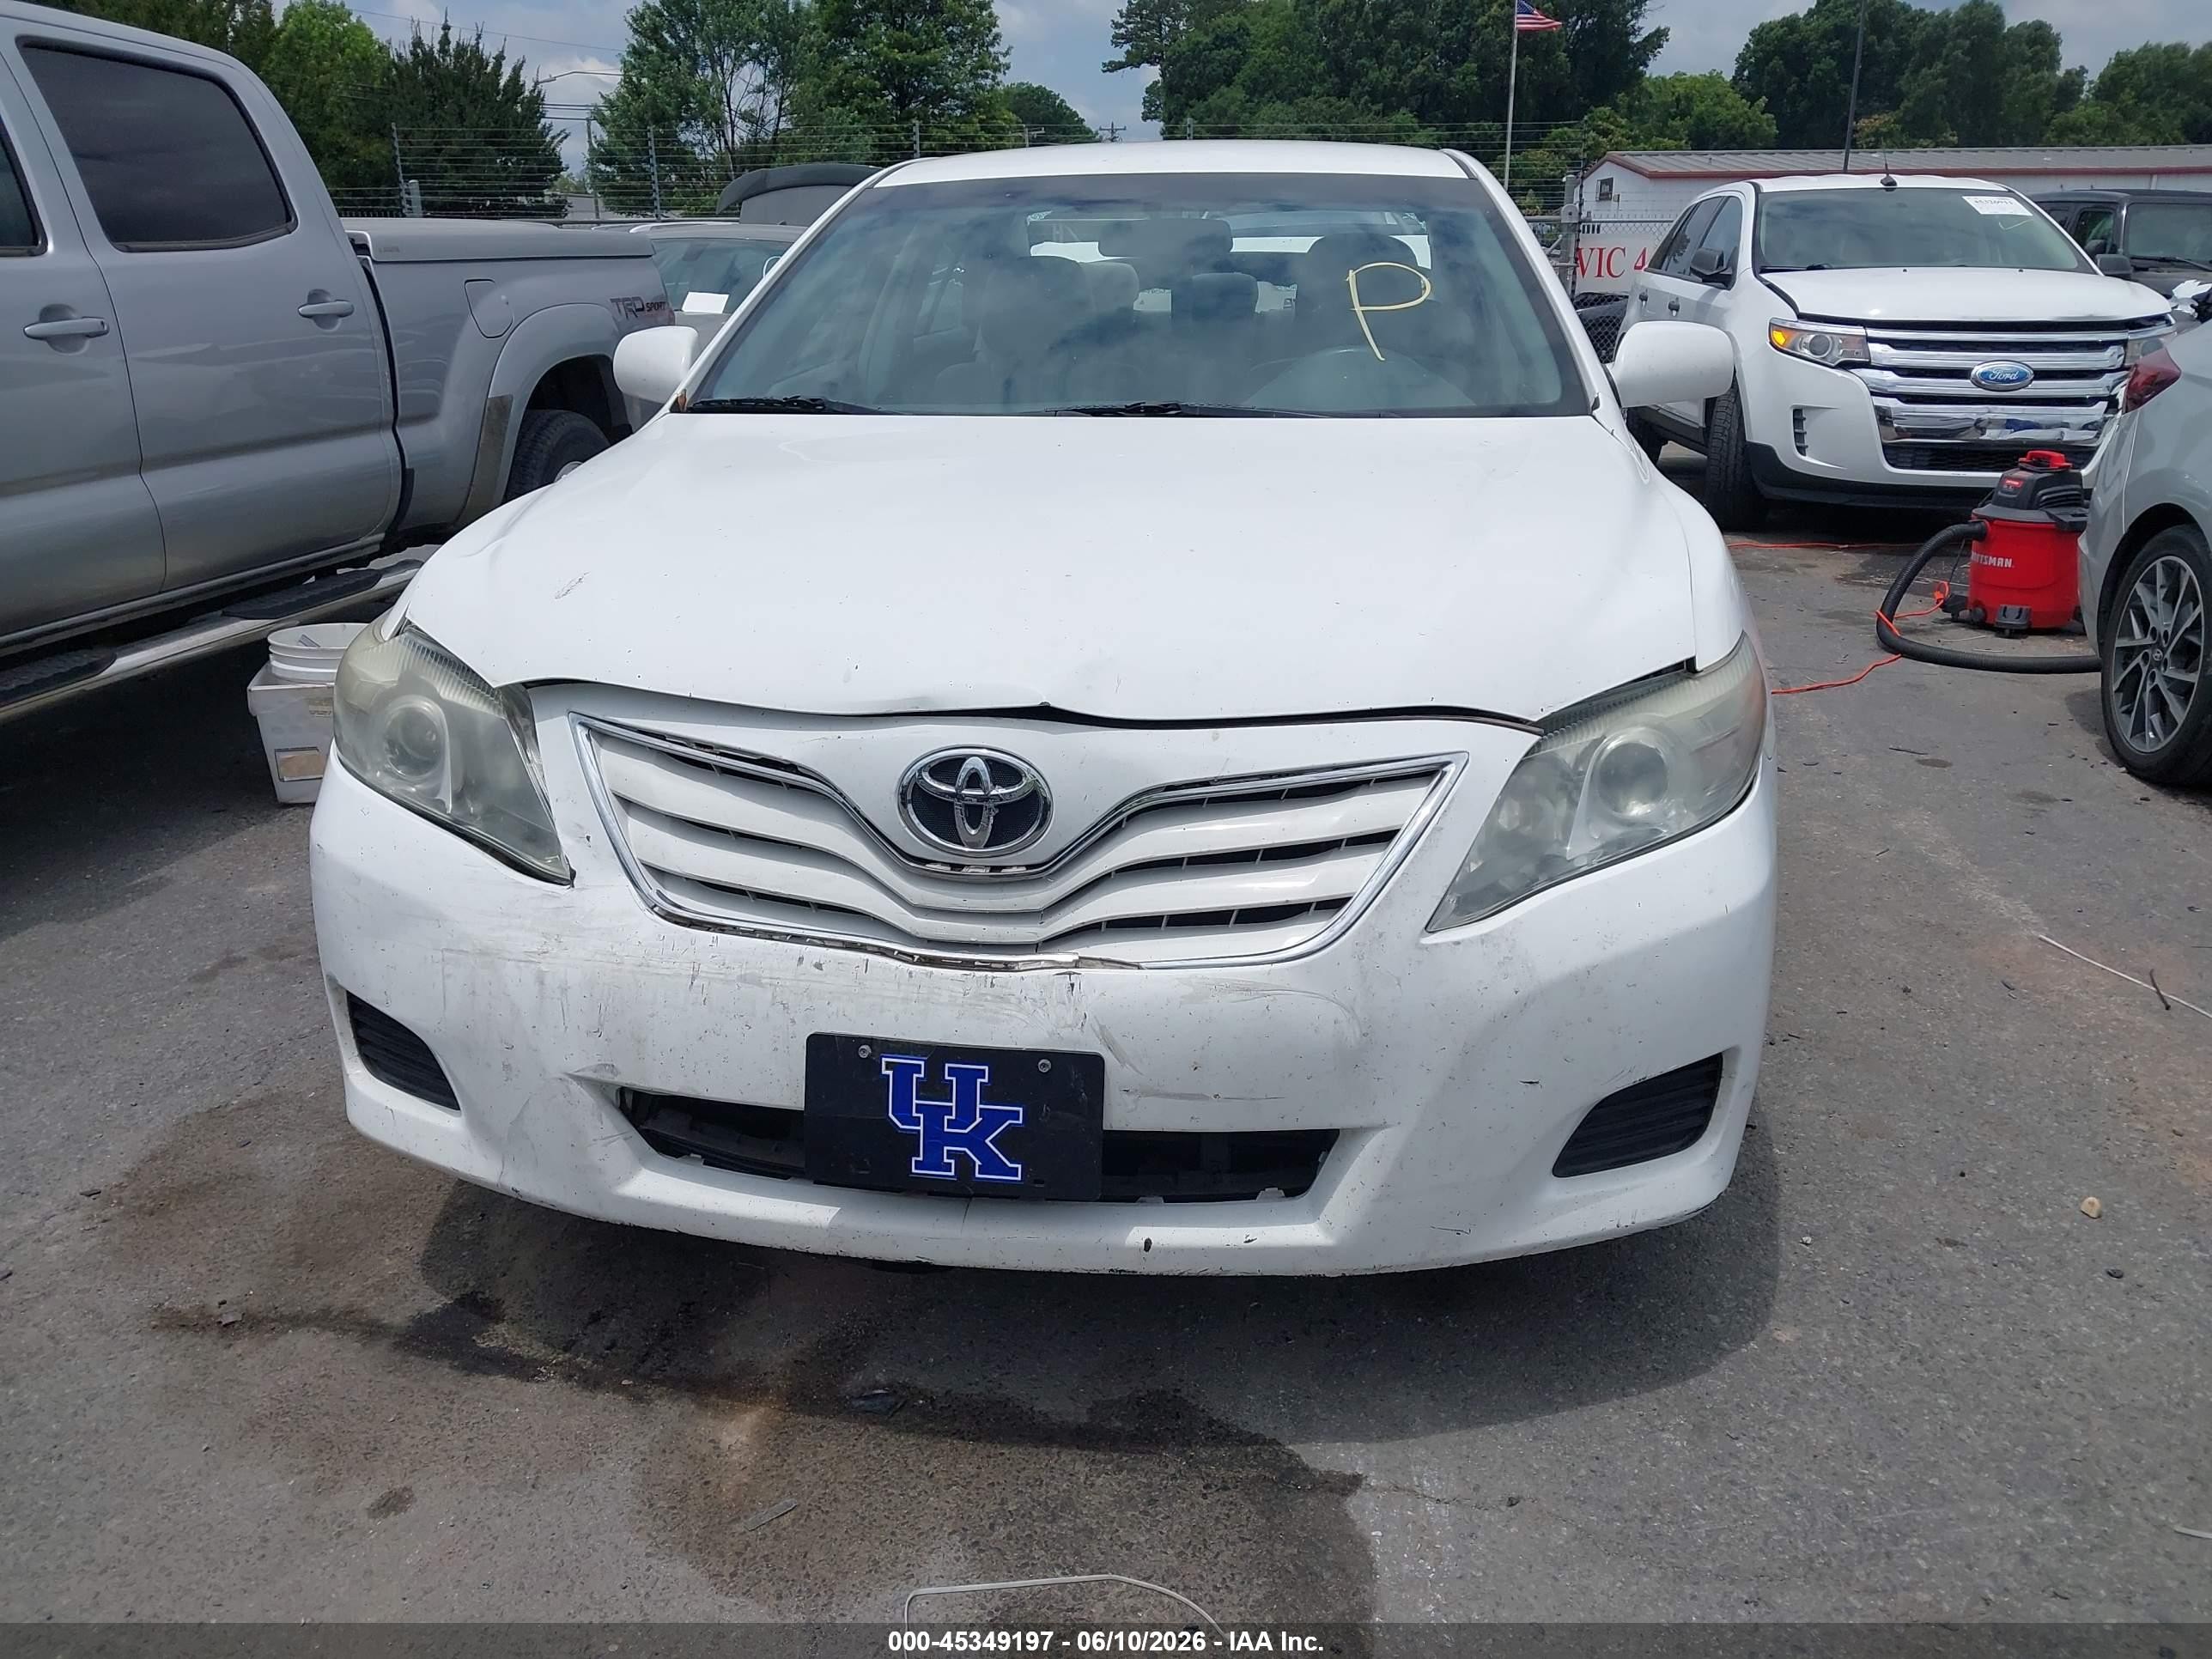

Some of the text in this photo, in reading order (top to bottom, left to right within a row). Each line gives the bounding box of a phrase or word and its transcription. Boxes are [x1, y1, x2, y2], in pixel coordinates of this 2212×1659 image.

[610, 296, 666, 319] TRD SPORT
[1346, 262, 1431, 361] P
[1989, 368, 2020, 380] Ford
[881, 1054, 1024, 1182] UK
